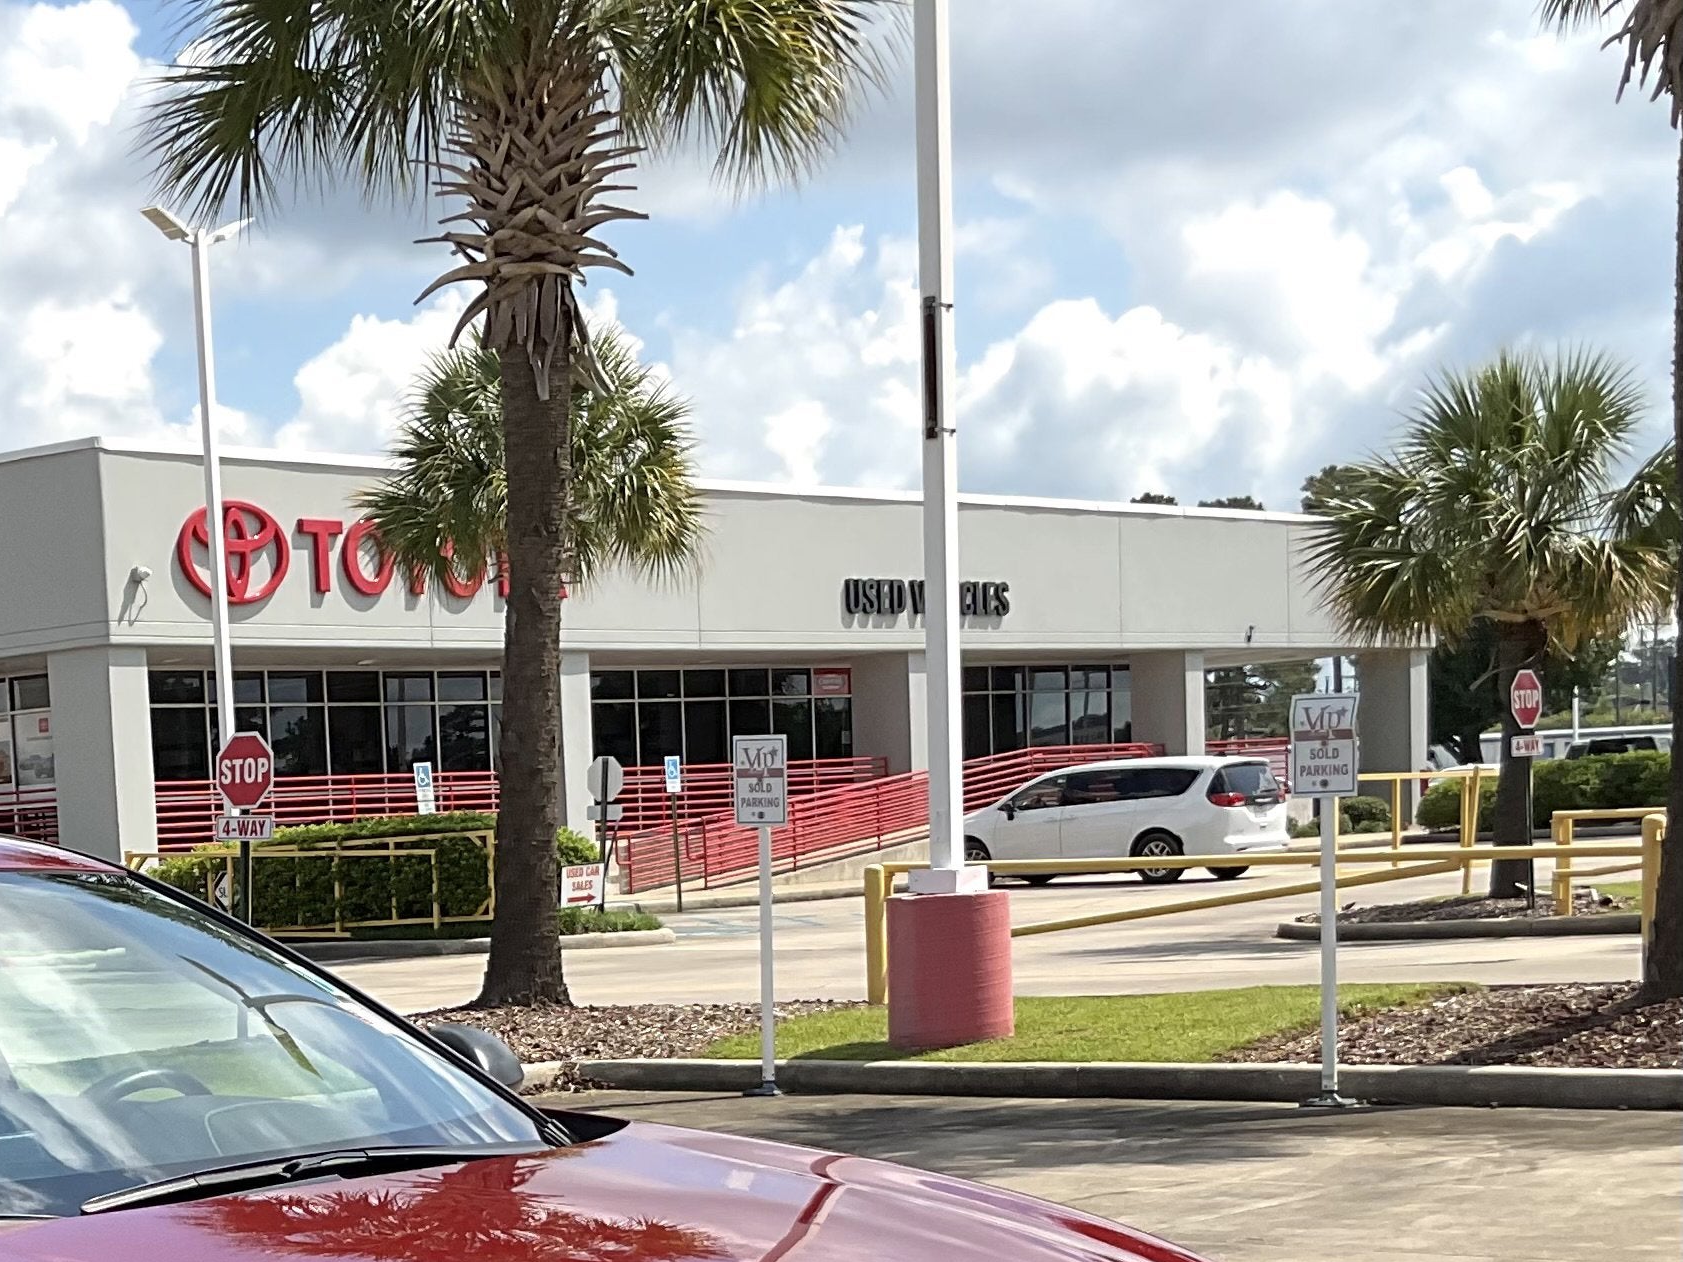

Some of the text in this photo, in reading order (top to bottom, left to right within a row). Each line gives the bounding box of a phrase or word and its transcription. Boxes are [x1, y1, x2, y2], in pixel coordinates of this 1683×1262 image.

[844, 578, 1010, 616] USED VCLES
[1514, 689, 1539, 709] STOP
[1516, 739, 1539, 752] 4-WAY
[1309, 748, 1339, 760] SOLD
[221, 757, 269, 785] STOP
[1299, 763, 1349, 777] PARKING
[748, 782, 773, 793] SOLD
[740, 797, 780, 808] PARKING
[222, 820, 266, 837] 4-WAY
[566, 865, 600, 878] USED CAR
[572, 880, 593, 891] SALES
